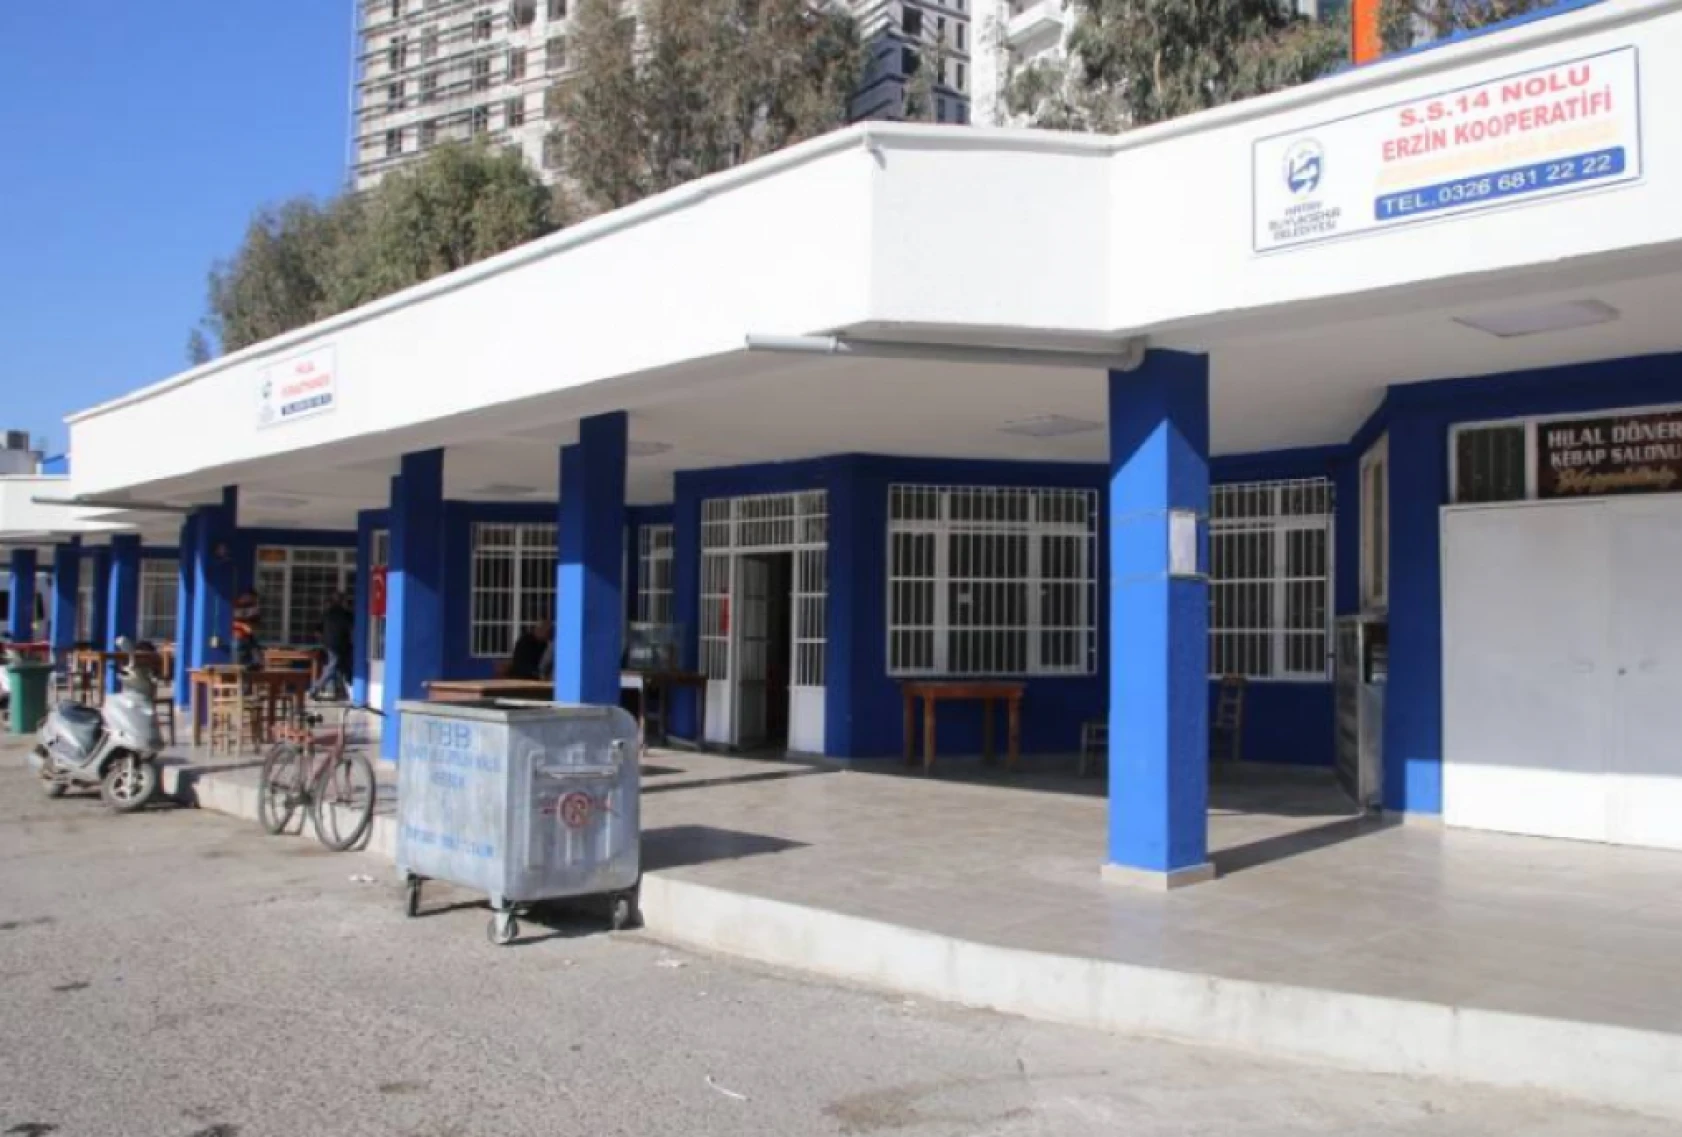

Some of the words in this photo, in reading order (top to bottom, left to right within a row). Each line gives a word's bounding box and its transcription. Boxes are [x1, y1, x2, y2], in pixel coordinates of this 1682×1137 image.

[1400, 90, 1490, 127] S.S.14
[1501, 66, 1591, 103] NOLU
[1382, 127, 1447, 162] ERZİN
[1454, 84, 1612, 143] KOOPERATİFİ
[1498, 168, 1538, 192] 681
[1547, 159, 1575, 179] 22
[1582, 152, 1612, 173] 22
[1550, 448, 1606, 468] KEBAP
[1611, 443, 1682, 464] SALONU
